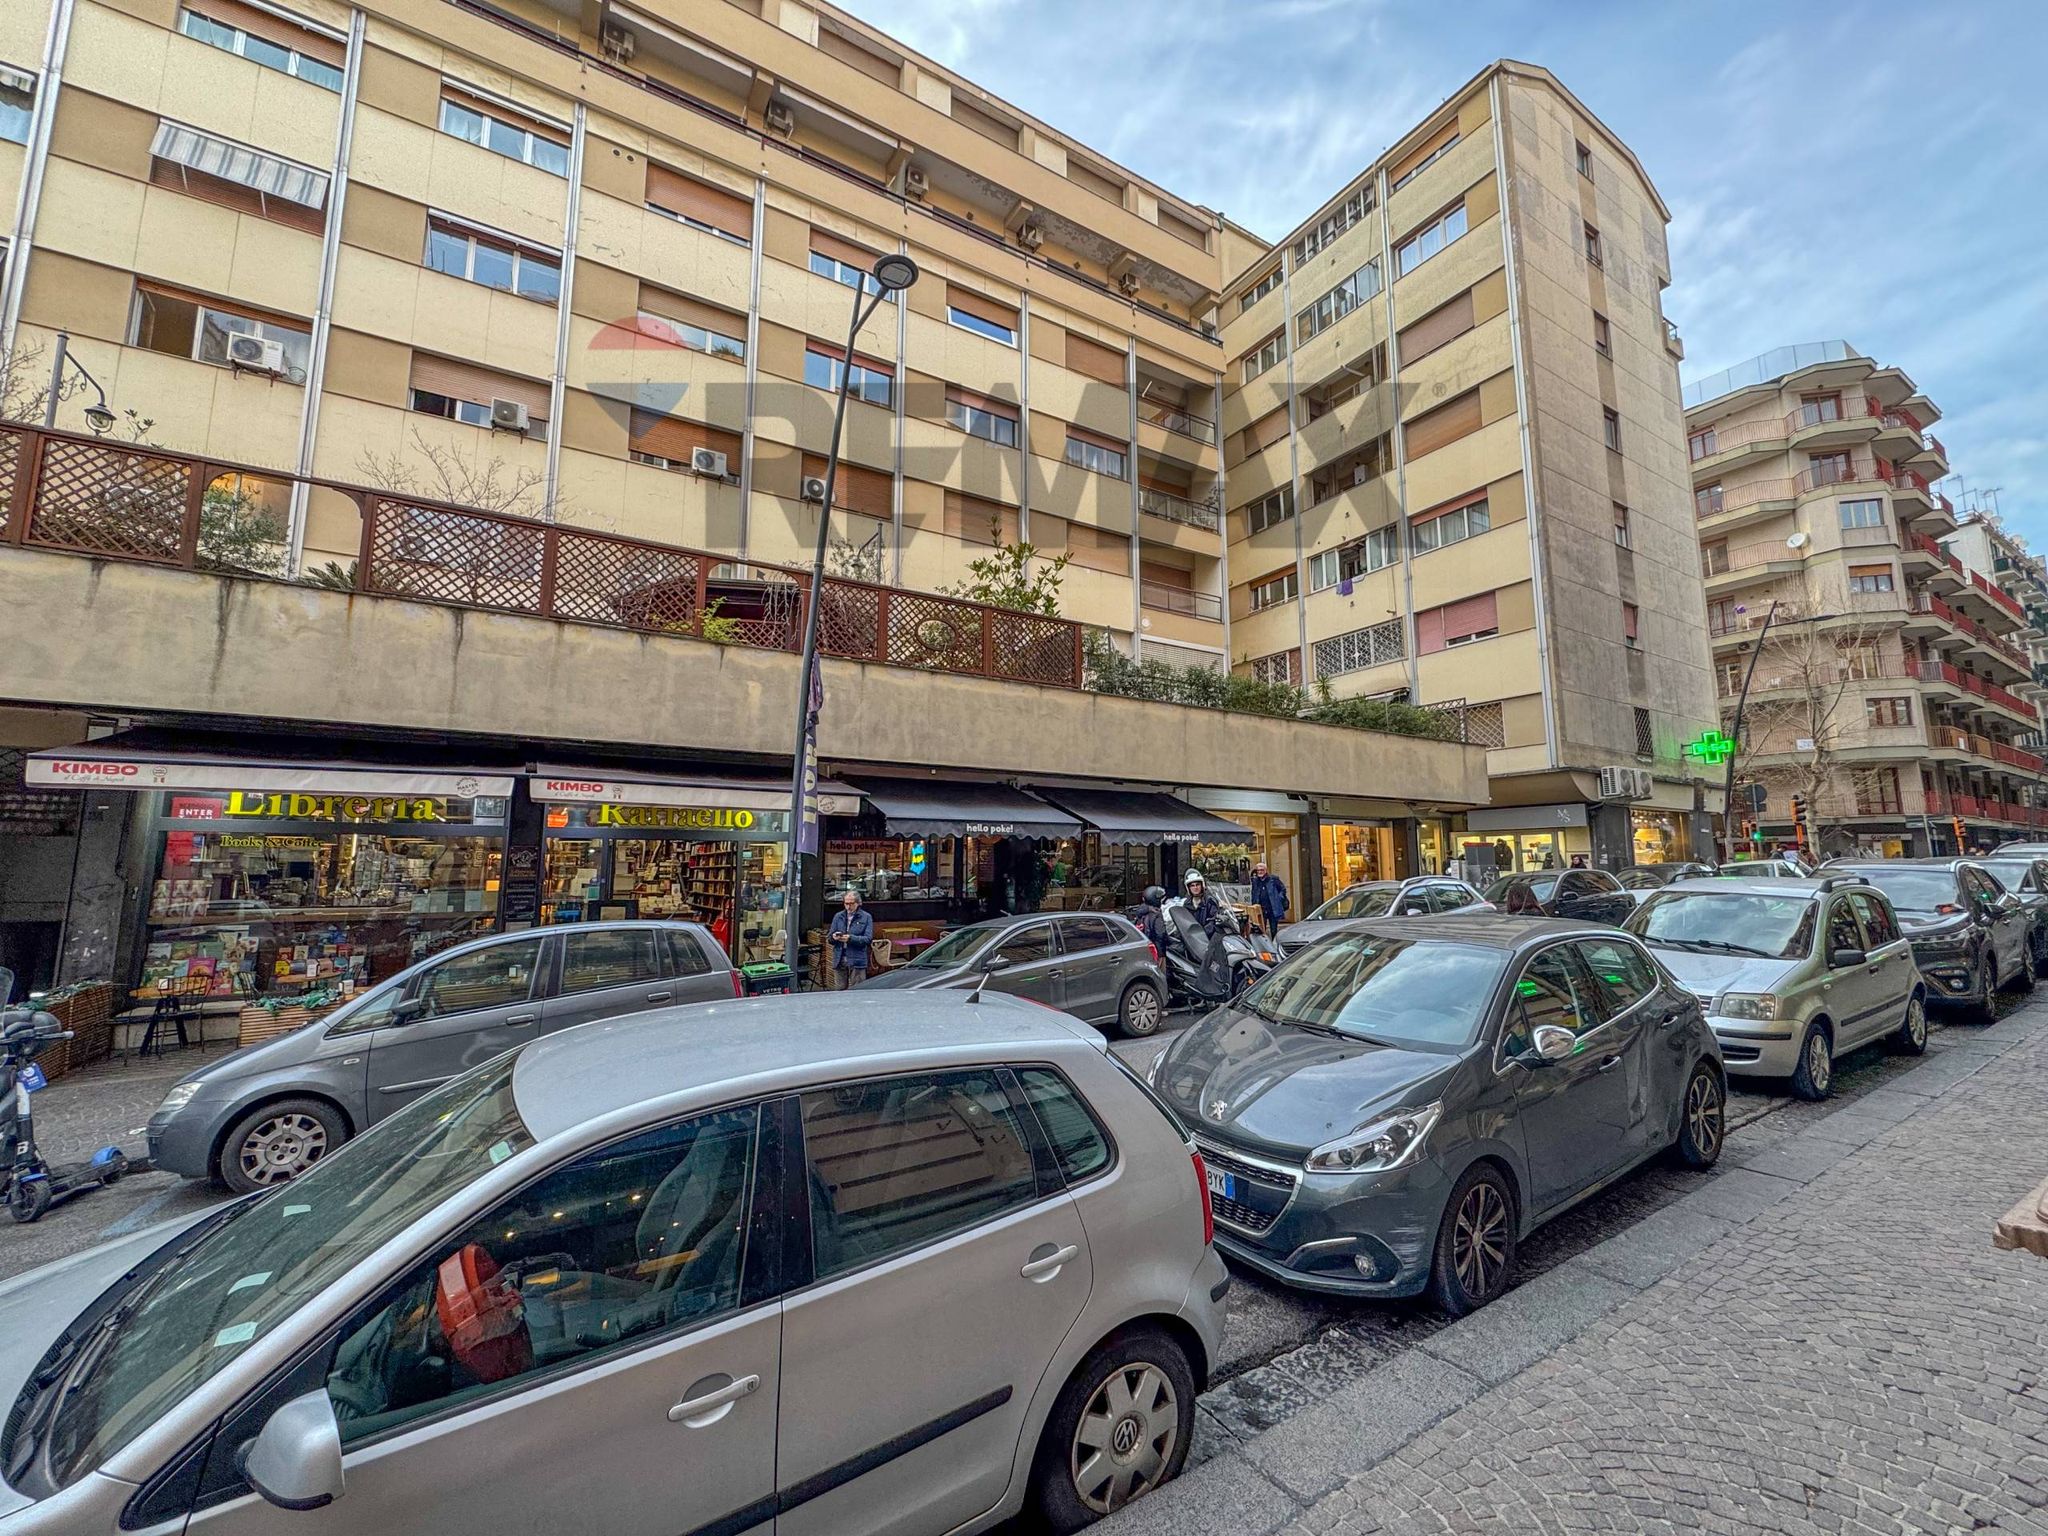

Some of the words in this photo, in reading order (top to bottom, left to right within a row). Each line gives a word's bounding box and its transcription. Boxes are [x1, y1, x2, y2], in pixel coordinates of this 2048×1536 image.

[52, 762, 138, 775] KIMBO
[547, 781, 604, 793] KIMBO
[224, 792, 435, 820] Libreria
[966, 823, 989, 832] hello
[990, 824, 1014, 834] poke!
[220, 835, 264, 848] Books
[1163, 833, 1181, 841] hello
[1181, 833, 1199, 842] poke!
[830, 841, 852, 850] hello
